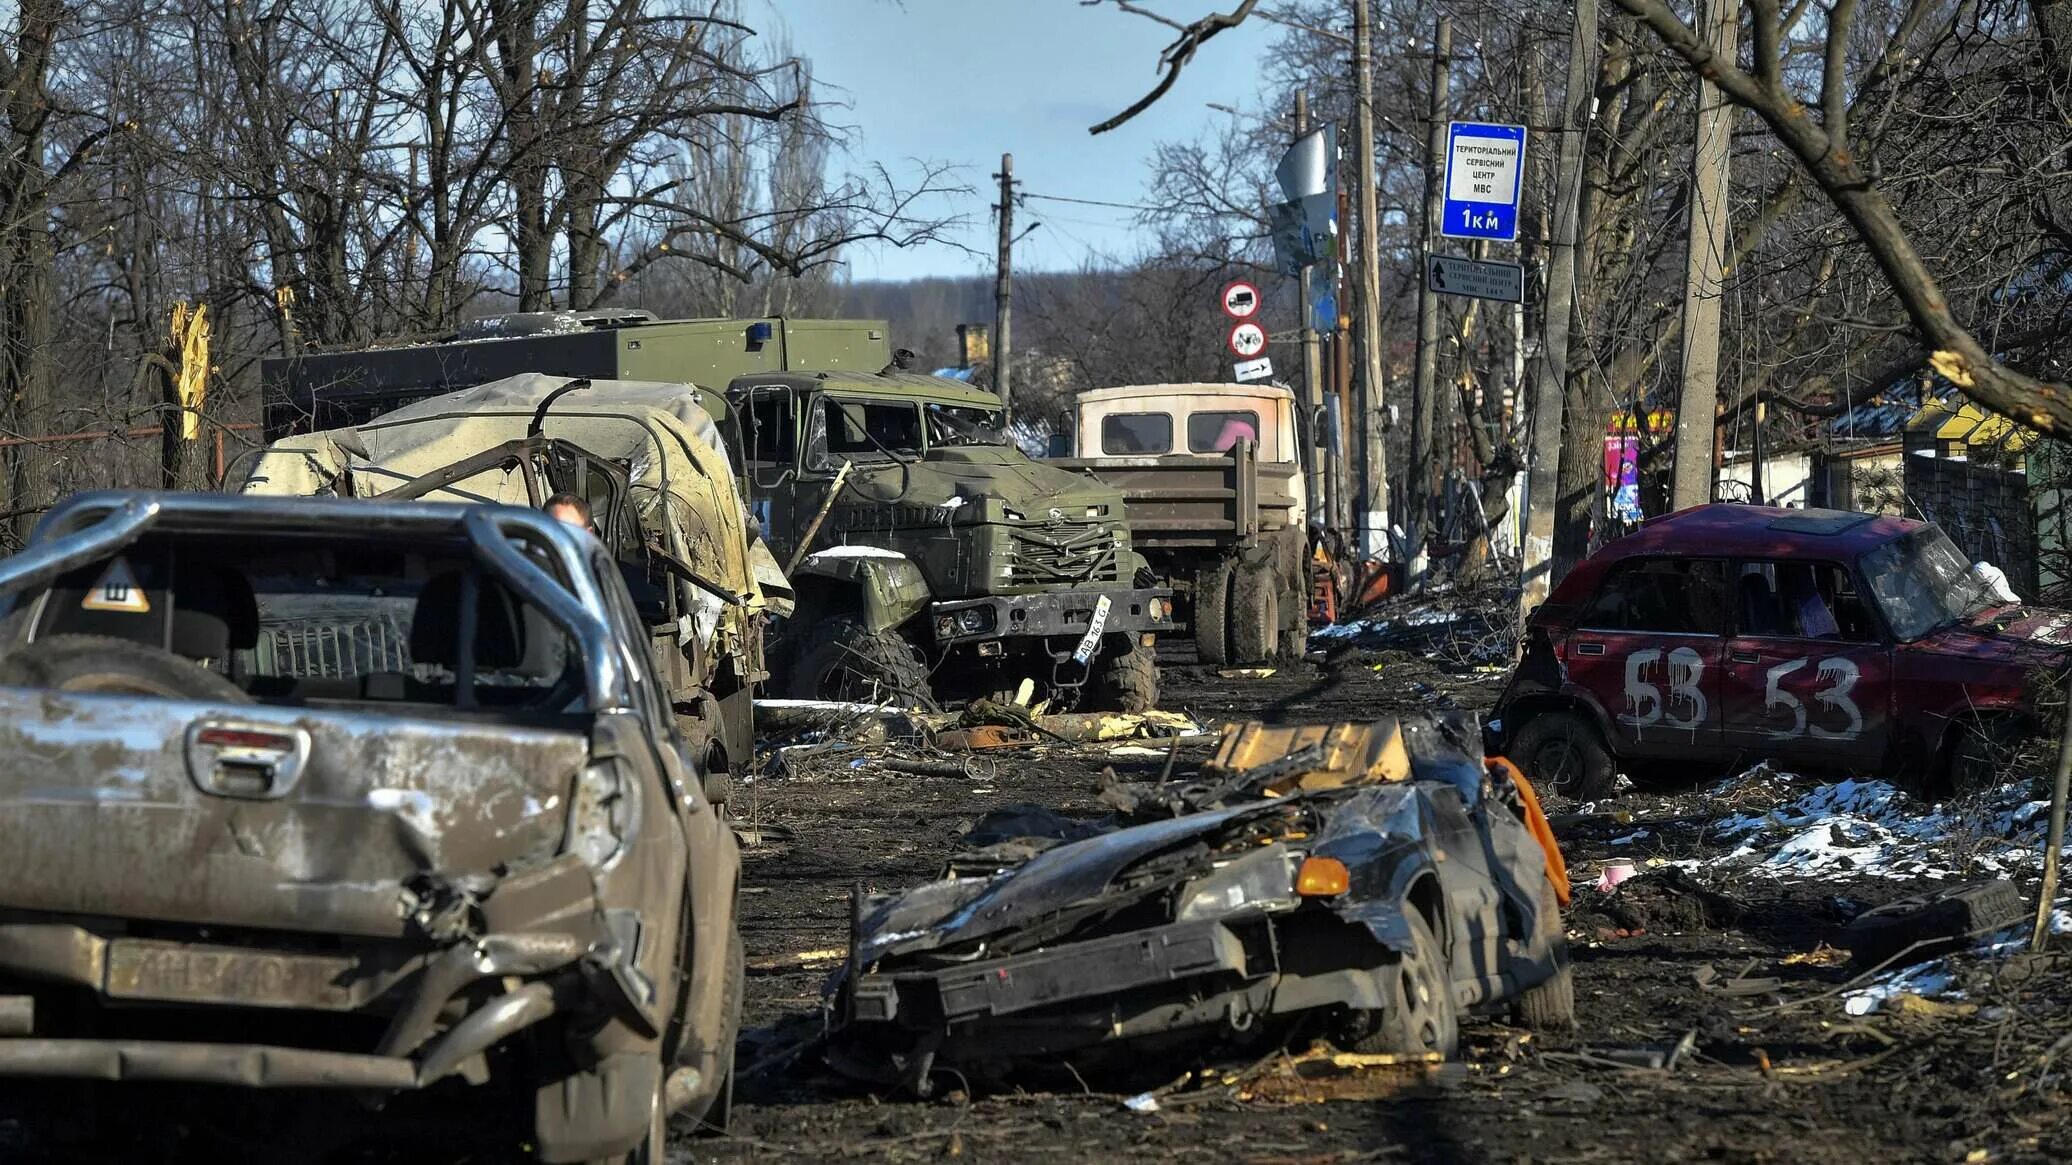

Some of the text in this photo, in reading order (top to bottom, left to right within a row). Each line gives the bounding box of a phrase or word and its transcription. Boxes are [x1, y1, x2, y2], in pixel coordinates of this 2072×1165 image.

[1456, 145, 1516, 156] ТЕРИТОРІАЛЬНИЙ
[1466, 158, 1505, 168] СЕРВІСНИЙ
[1472, 171, 1495, 180] ЦЕНТР
[1473, 184, 1492, 193] МВС
[106, 583, 127, 601] Ш
[1763, 655, 1864, 741] 53
